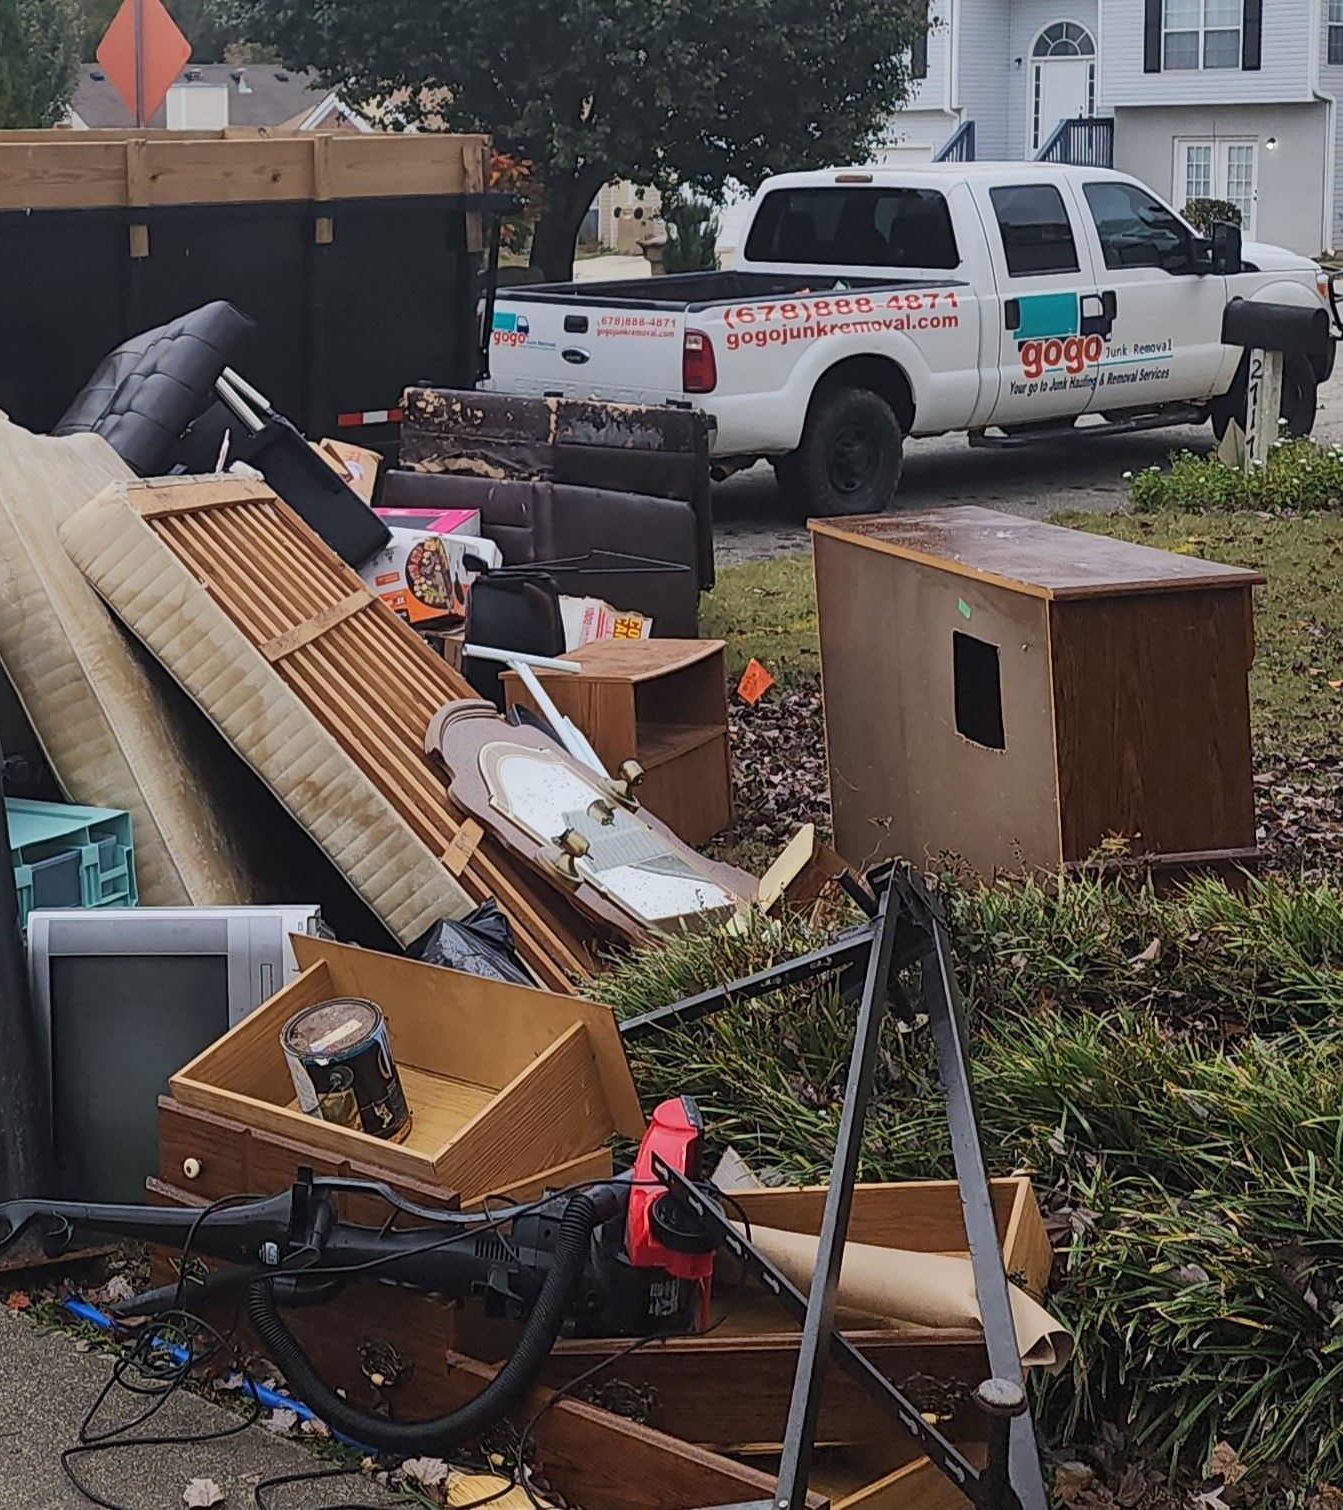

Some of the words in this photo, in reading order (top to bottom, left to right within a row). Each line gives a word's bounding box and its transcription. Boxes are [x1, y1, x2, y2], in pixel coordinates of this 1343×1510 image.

[597, 315, 676, 328] (678)888-4871
[723, 292, 959, 329] (678)888-4871
[494, 331, 526, 347] gogo
[726, 314, 959, 350] gogojunkremoval.com
[1021, 335, 1103, 379] gogo
[1106, 343, 1128, 358] Junk
[1133, 338, 1172, 355] Removal
[1010, 381, 1027, 395] Your
[1027, 382, 1038, 397] go
[1039, 380, 1048, 392] to
[1049, 377, 1067, 391] Junk
[1099, 372, 1105, 386] &
[1106, 369, 1138, 385] Removal
[1139, 367, 1170, 382] Services
